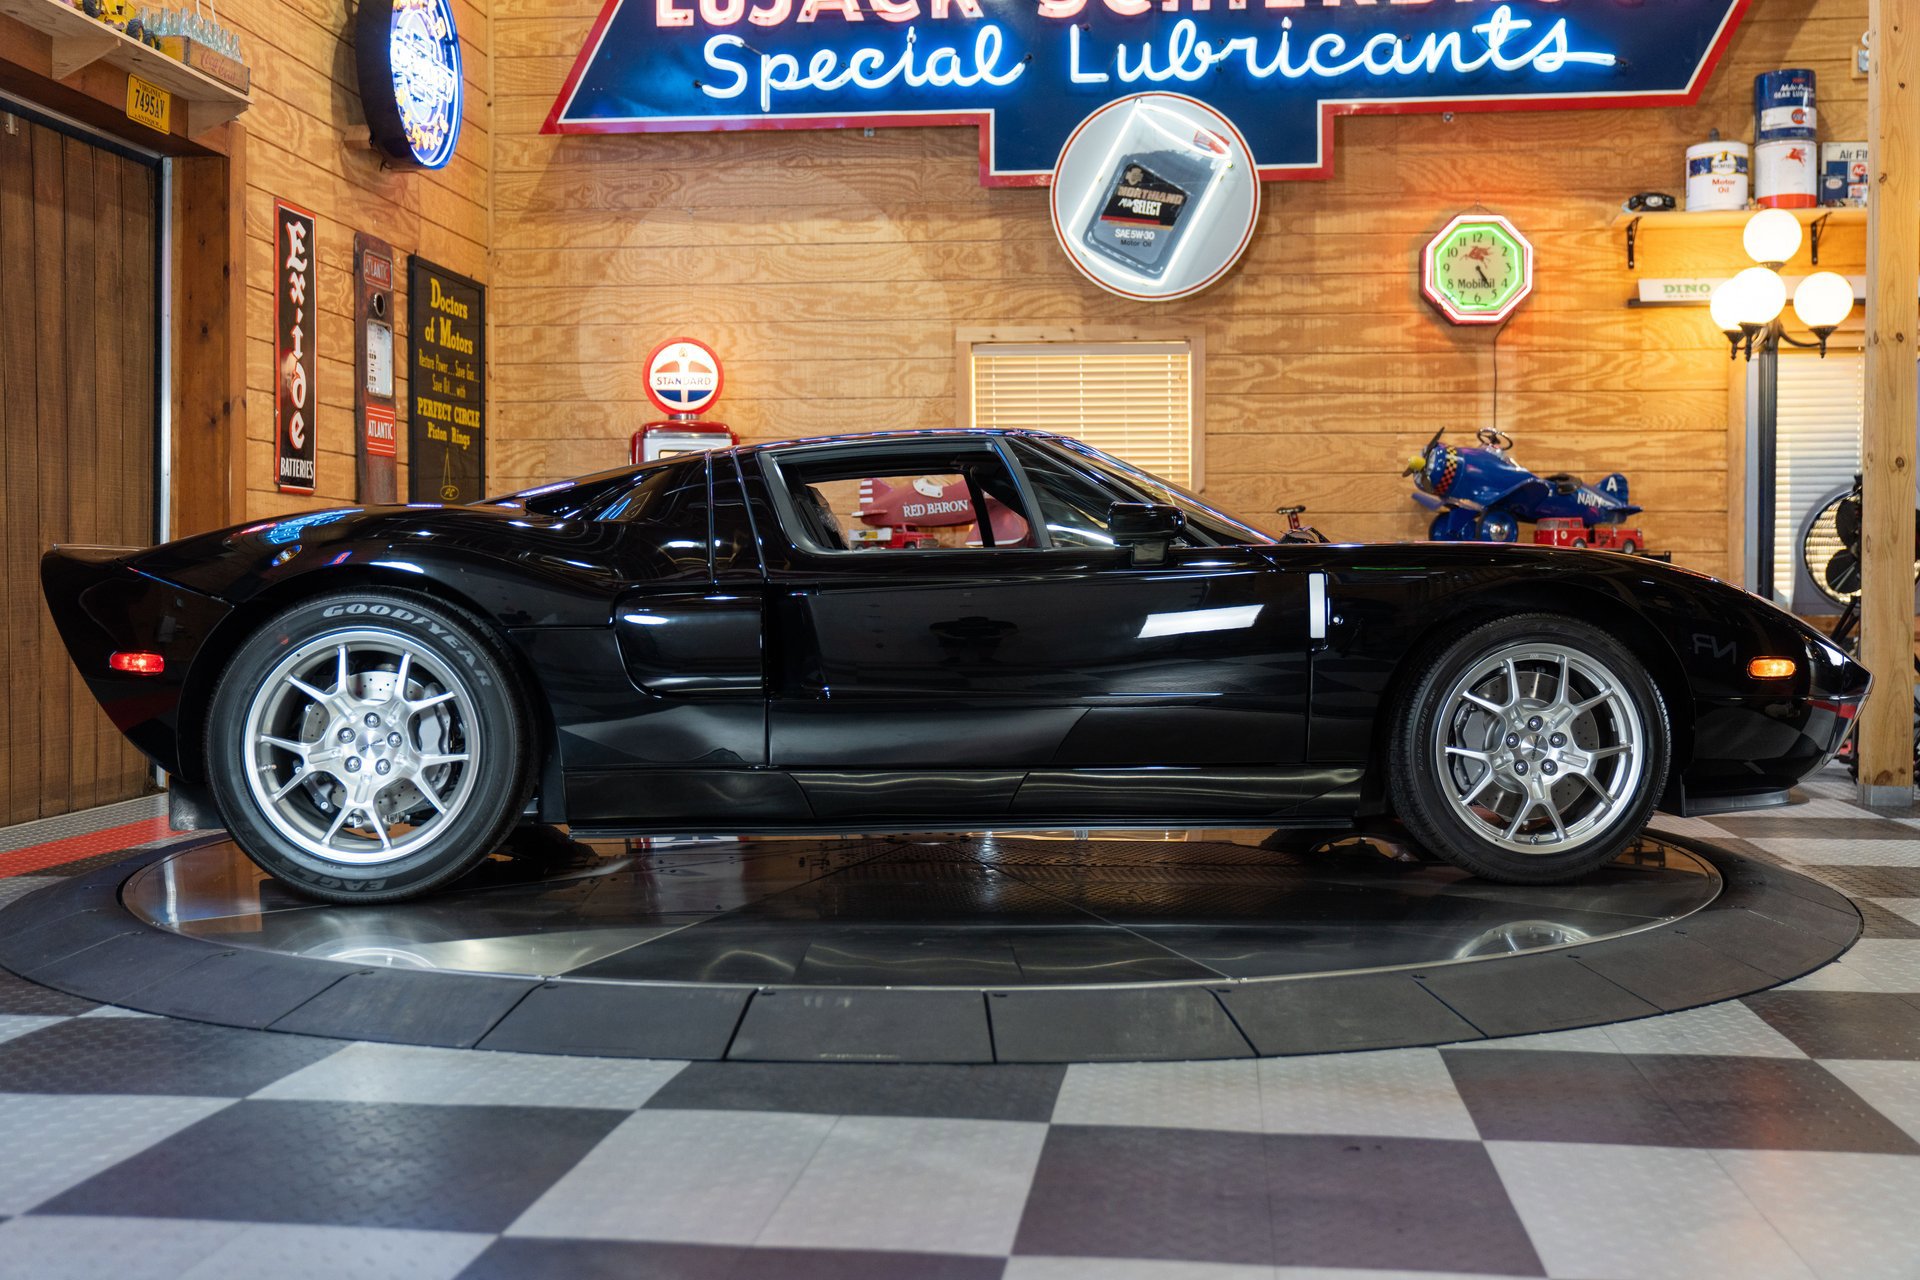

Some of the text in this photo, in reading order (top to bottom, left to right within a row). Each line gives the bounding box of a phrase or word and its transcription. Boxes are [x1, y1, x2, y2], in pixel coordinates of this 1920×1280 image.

[701, 6, 1616, 112] Special Lubricants
[1839, 150, 1853, 159] Air
[1114, 228, 1131, 239] SAE
[1459, 237, 1466, 246] 11
[1473, 233, 1483, 242] 12
[1120, 239, 1152, 248] Motor Oil
[1447, 248, 1458, 257] 10
[1663, 284, 1711, 294] DINO
[430, 277, 468, 319] Doctors
[285, 221, 308, 449] Exide
[425, 316, 473, 355] of Motors
[455, 360, 465, 378] Save
[432, 373, 442, 392] Save
[456, 385, 466, 398] with
[656, 377, 711, 386] STANDARD
[417, 396, 480, 428] PERFECT CIRCLE
[368, 419, 393, 440] ATLANTIC
[427, 421, 470, 450] Piston Rings
[280, 456, 313, 480] BATTERIES
[1606, 476, 1617, 492] A
[1577, 491, 1602, 508] NAVY
[903, 500, 969, 517] RED BARON
[323, 603, 495, 687] GOODYEAR
